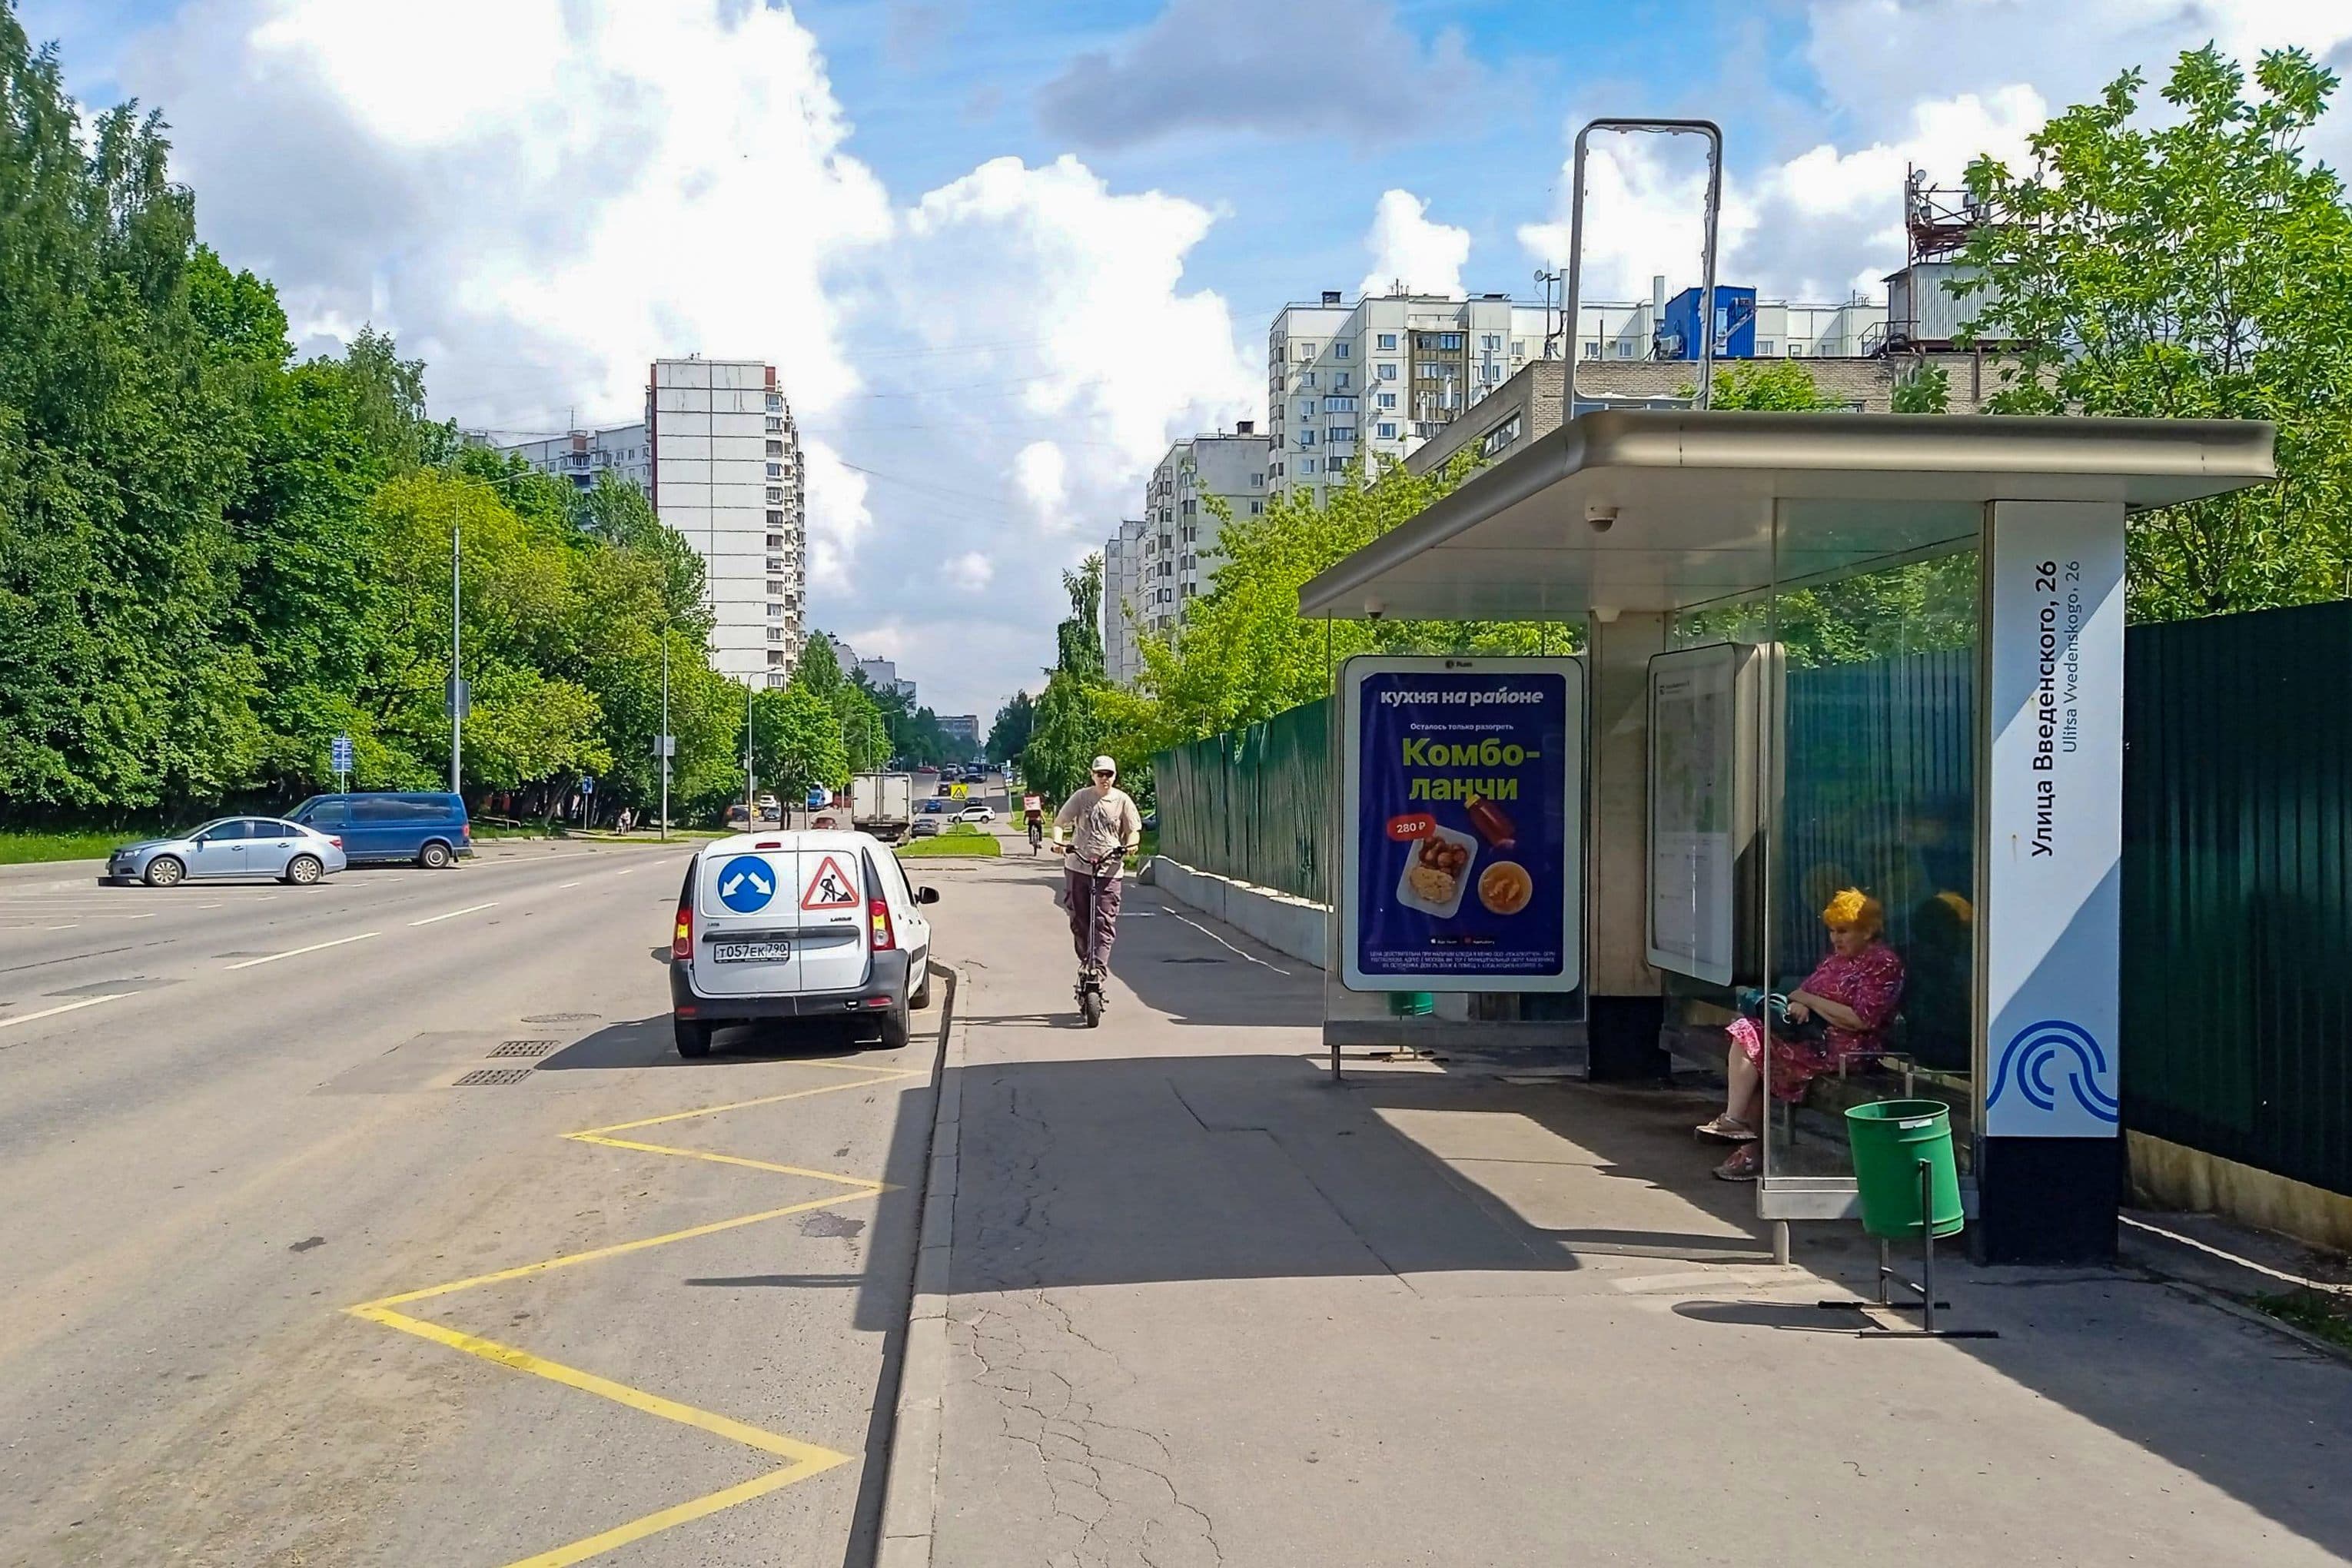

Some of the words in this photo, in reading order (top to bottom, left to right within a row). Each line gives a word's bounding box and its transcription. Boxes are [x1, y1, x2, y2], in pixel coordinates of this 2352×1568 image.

[2035, 560, 2057, 593] 26
[2065, 561, 2080, 582] 26
[2063, 587, 2081, 704] Vvedenskogo,
[1380, 691, 1438, 707] кухня
[1442, 692, 1467, 703] на
[1470, 686, 1544, 707] районе
[2032, 600, 2060, 771] Введенского,
[2062, 708, 2078, 752] Ulitsa
[1402, 738, 1540, 766] Комбо-
[1409, 779, 1518, 800] ланчи
[1396, 822, 1417, 833] 280
[2031, 779, 2056, 857] Улица
[767, 943, 786, 953] 790
